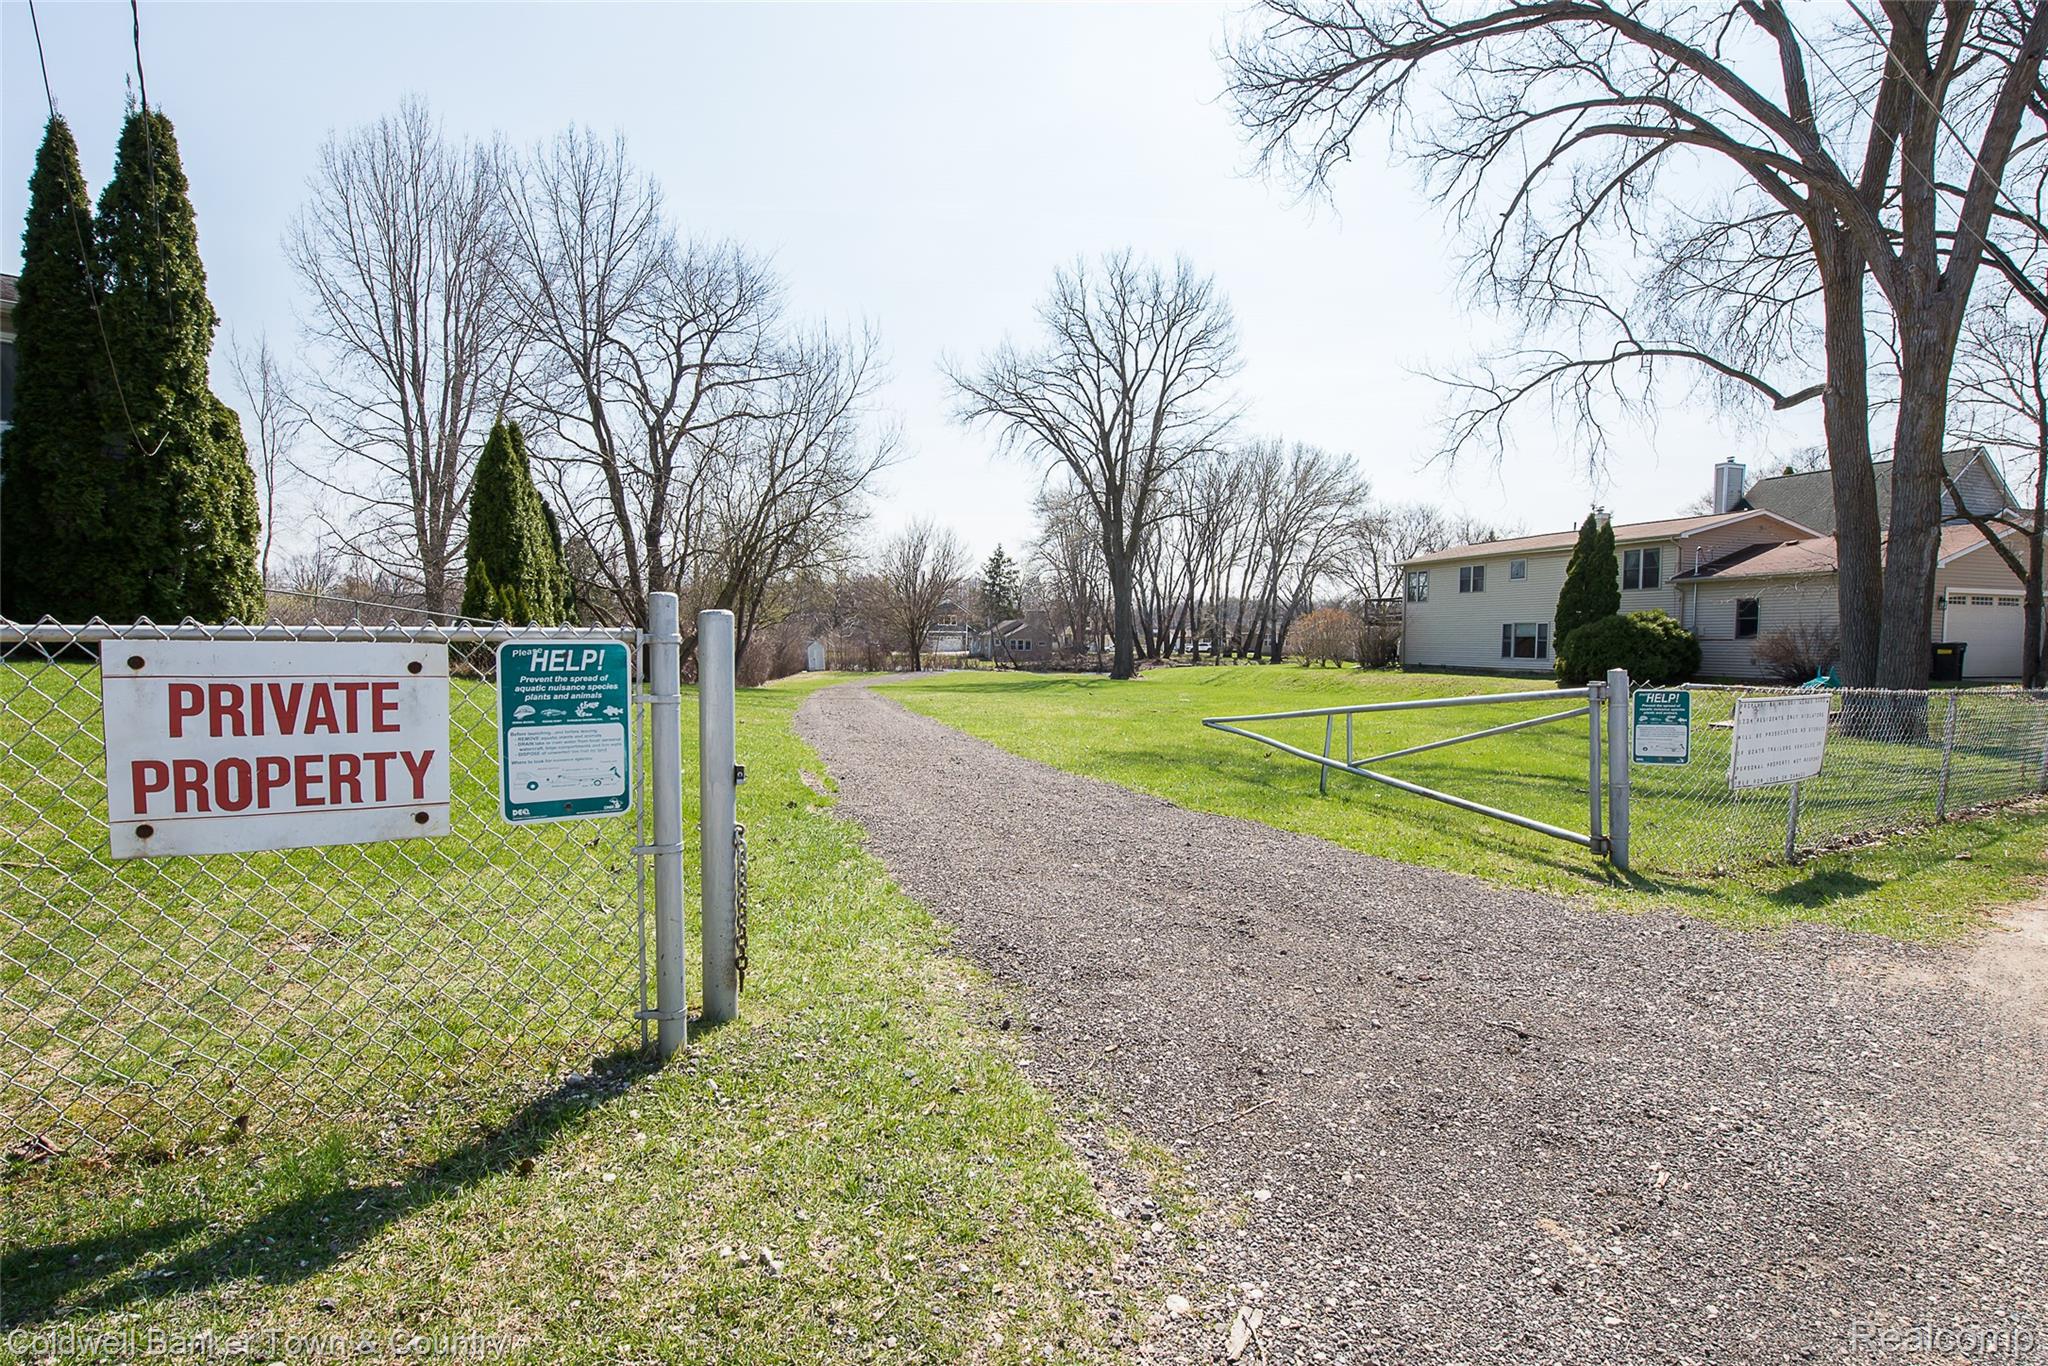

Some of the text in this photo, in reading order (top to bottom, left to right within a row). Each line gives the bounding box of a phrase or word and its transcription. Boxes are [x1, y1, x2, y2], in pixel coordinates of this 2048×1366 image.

[511, 647, 543, 658] Please
[529, 649, 606, 672] HELP!
[519, 674, 609, 684] Prevent the spread of
[514, 685, 547, 693] aquatic
[587, 682, 619, 692] species
[524, 691, 603, 702] plants and animals
[1645, 693, 1680, 703] HELP!
[167, 681, 401, 739] PRIVATE
[131, 750, 436, 814] PROPERTY
